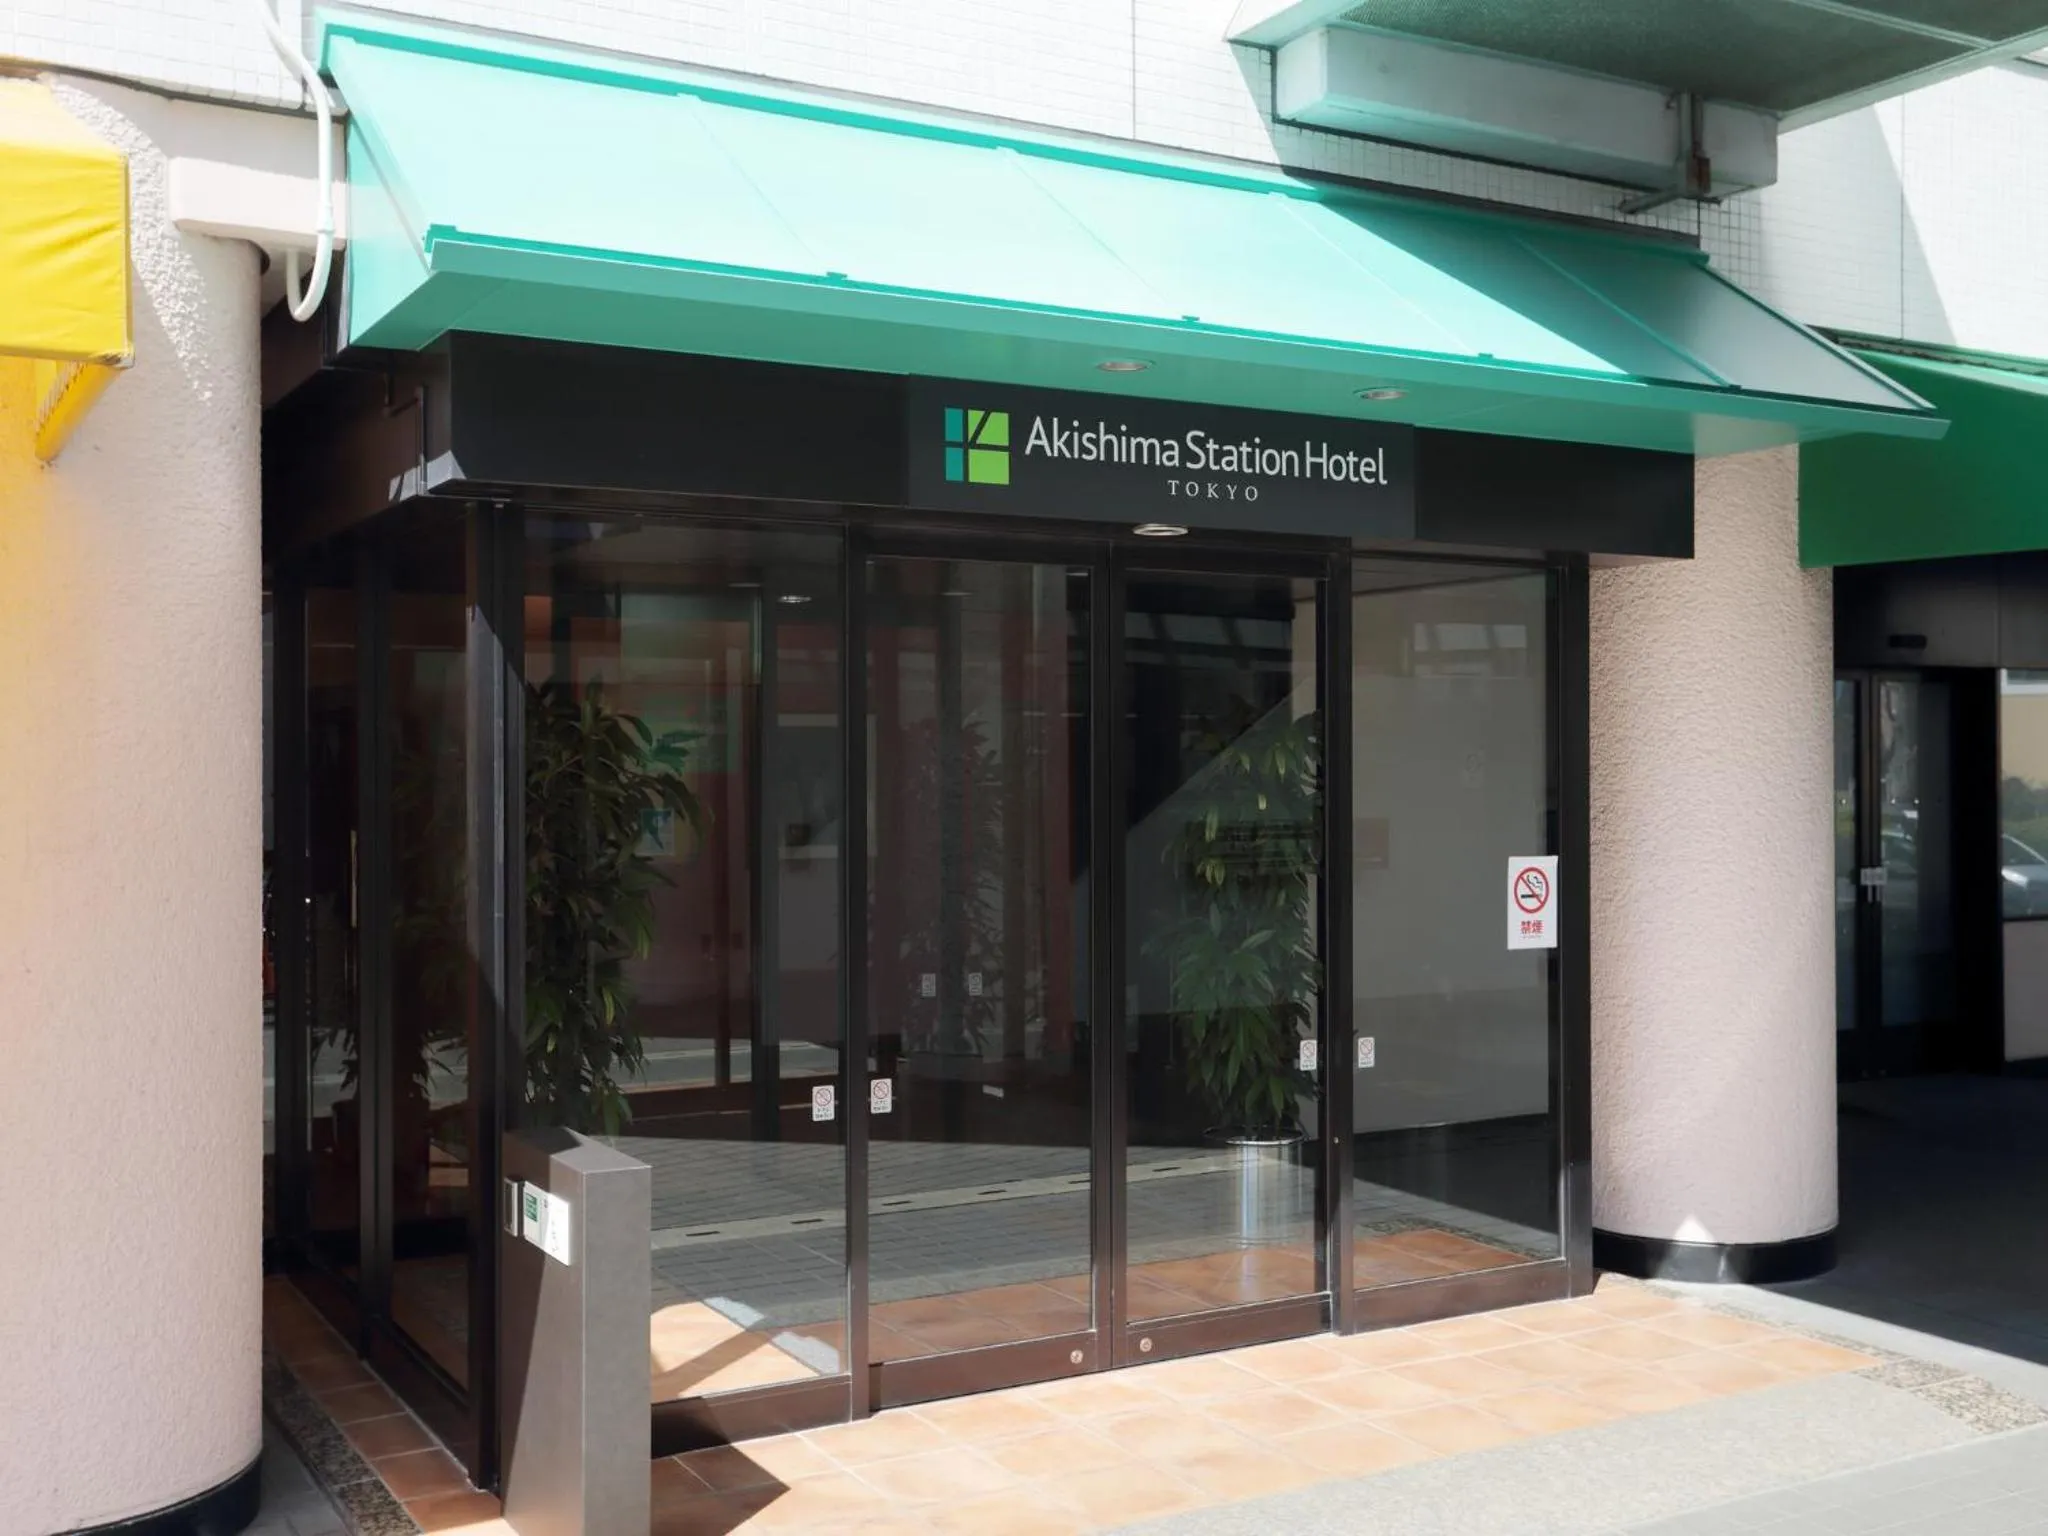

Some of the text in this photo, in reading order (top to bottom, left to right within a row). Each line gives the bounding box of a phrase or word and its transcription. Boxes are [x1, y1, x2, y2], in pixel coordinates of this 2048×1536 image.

[1024, 416, 1388, 485] Akishima Station Hotel
[1167, 479, 1259, 502] TOKYO
[1520, 920, 1543, 934] 禁煙
